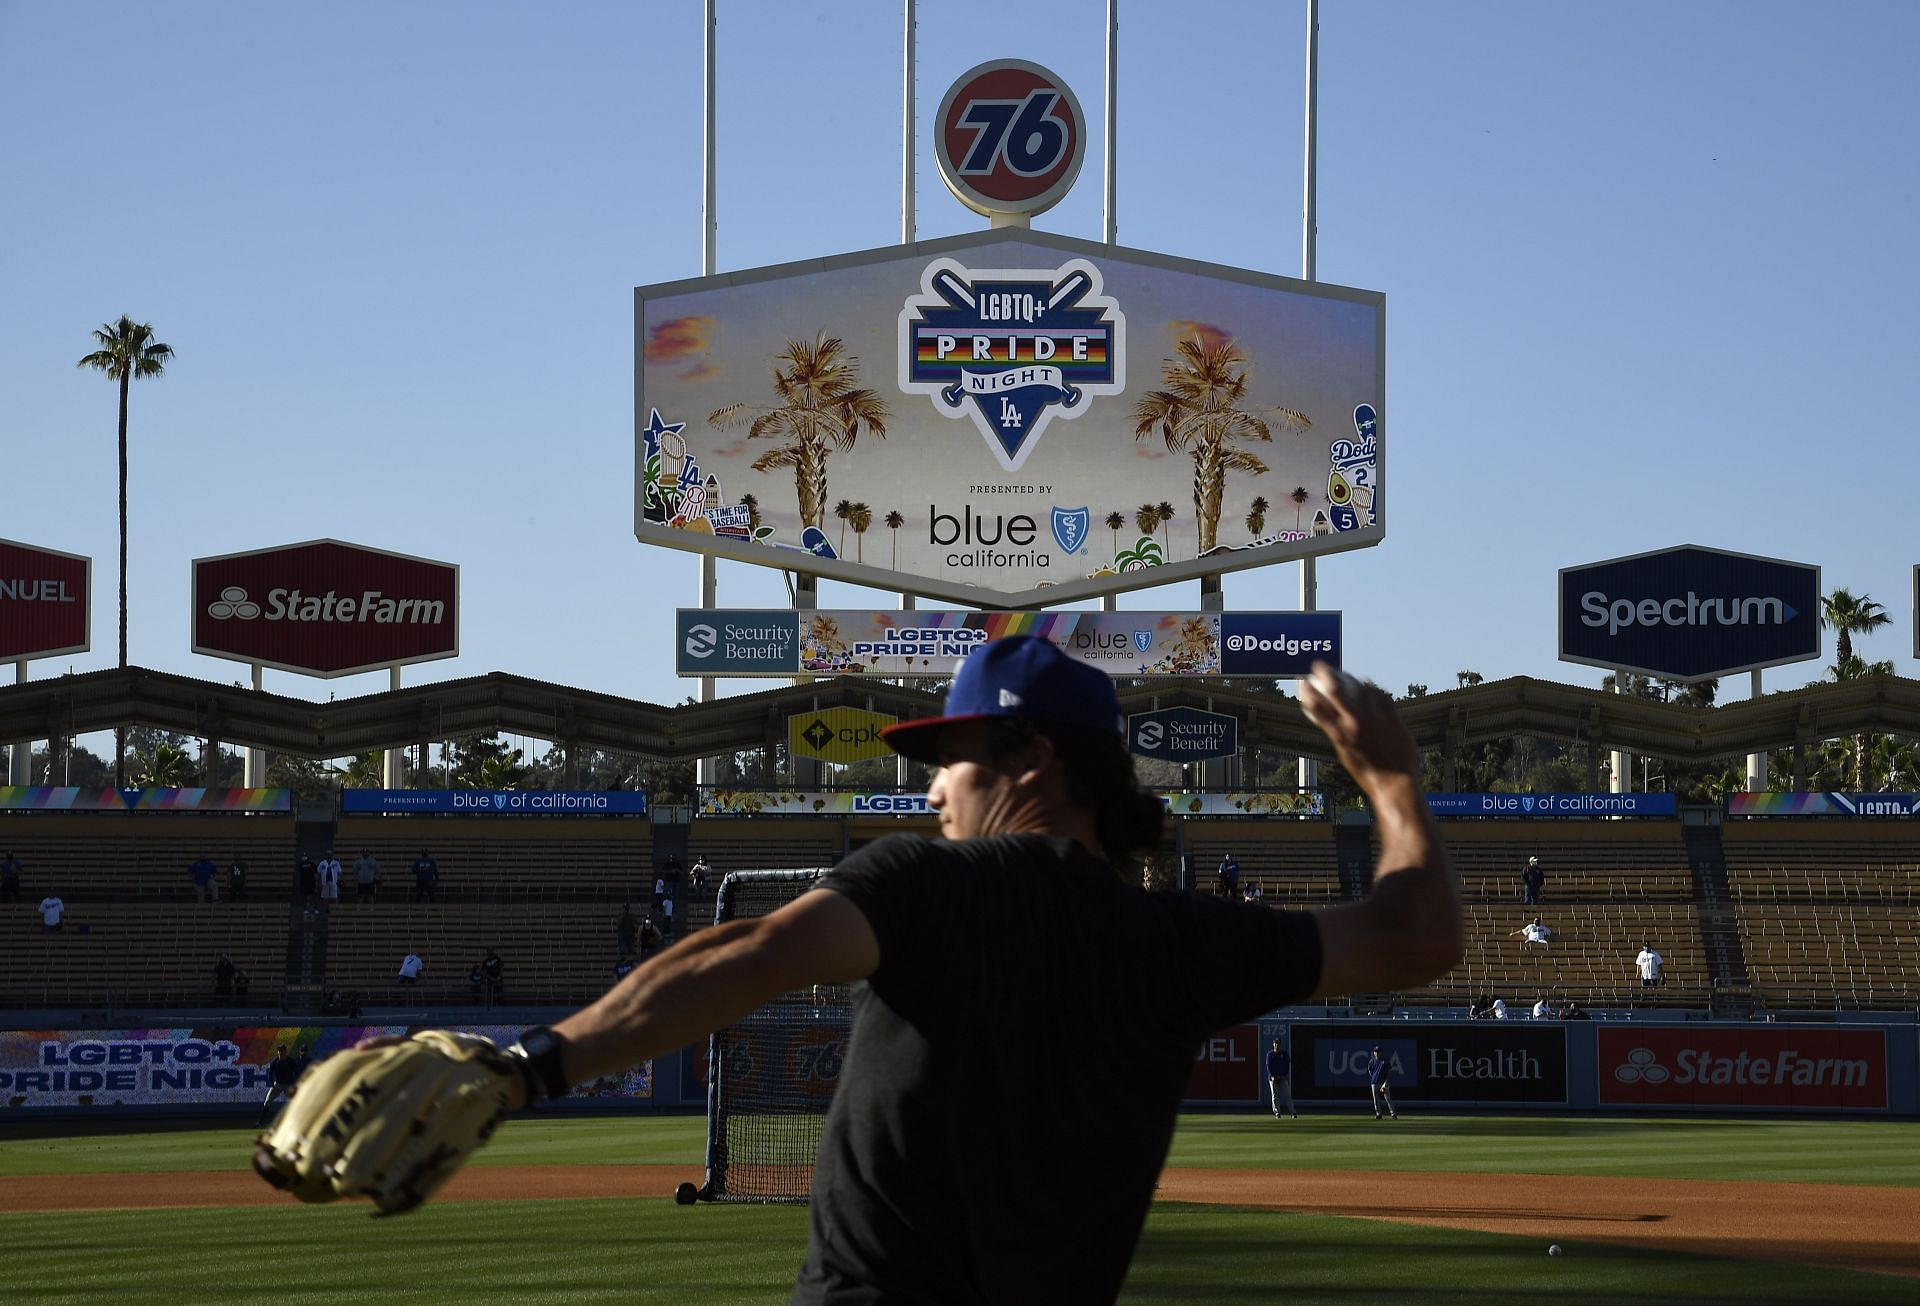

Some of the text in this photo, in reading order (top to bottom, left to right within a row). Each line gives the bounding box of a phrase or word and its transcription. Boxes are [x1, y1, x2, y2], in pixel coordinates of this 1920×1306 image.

[955, 88, 1068, 177] 76
[980, 293, 1046, 322] LGBTQ+
[936, 335, 1089, 361] PRIDE
[971, 369, 1053, 389] NIGHT
[1000, 396, 1022, 427] LA
[969, 486, 1053, 494] PRESENTED BY
[716, 507, 733, 518] TIME
[734, 505, 748, 516] FOR
[929, 504, 1037, 546] blue
[1341, 514, 1352, 528] 5
[946, 549, 1049, 567] california
[1580, 591, 1783, 636] Spectrum
[725, 624, 793, 645] Security
[886, 630, 986, 641] LGBTQ+
[1076, 629, 1127, 649] blue
[725, 644, 784, 659] Benefit
[855, 644, 934, 655] PRIDE
[1226, 634, 1332, 655] @Dodgers
[1084, 649, 1134, 659] california
[1170, 721, 1226, 737] Security
[1170, 736, 1218, 750] Benefit
[453, 793, 489, 807] blue
[510, 793, 527, 808] of
[531, 793, 608, 808] california
[855, 797, 938, 810] LGBT
[1483, 796, 1518, 810] blue
[1539, 796, 1554, 810] of
[1559, 796, 1636, 810] california
[1262, 1024, 1286, 1035] 375
[43, 1042, 236, 1065] LGBTQ+
[1328, 1048, 1543, 1080] UCA Health
[152, 1068, 272, 1091] NIGH
